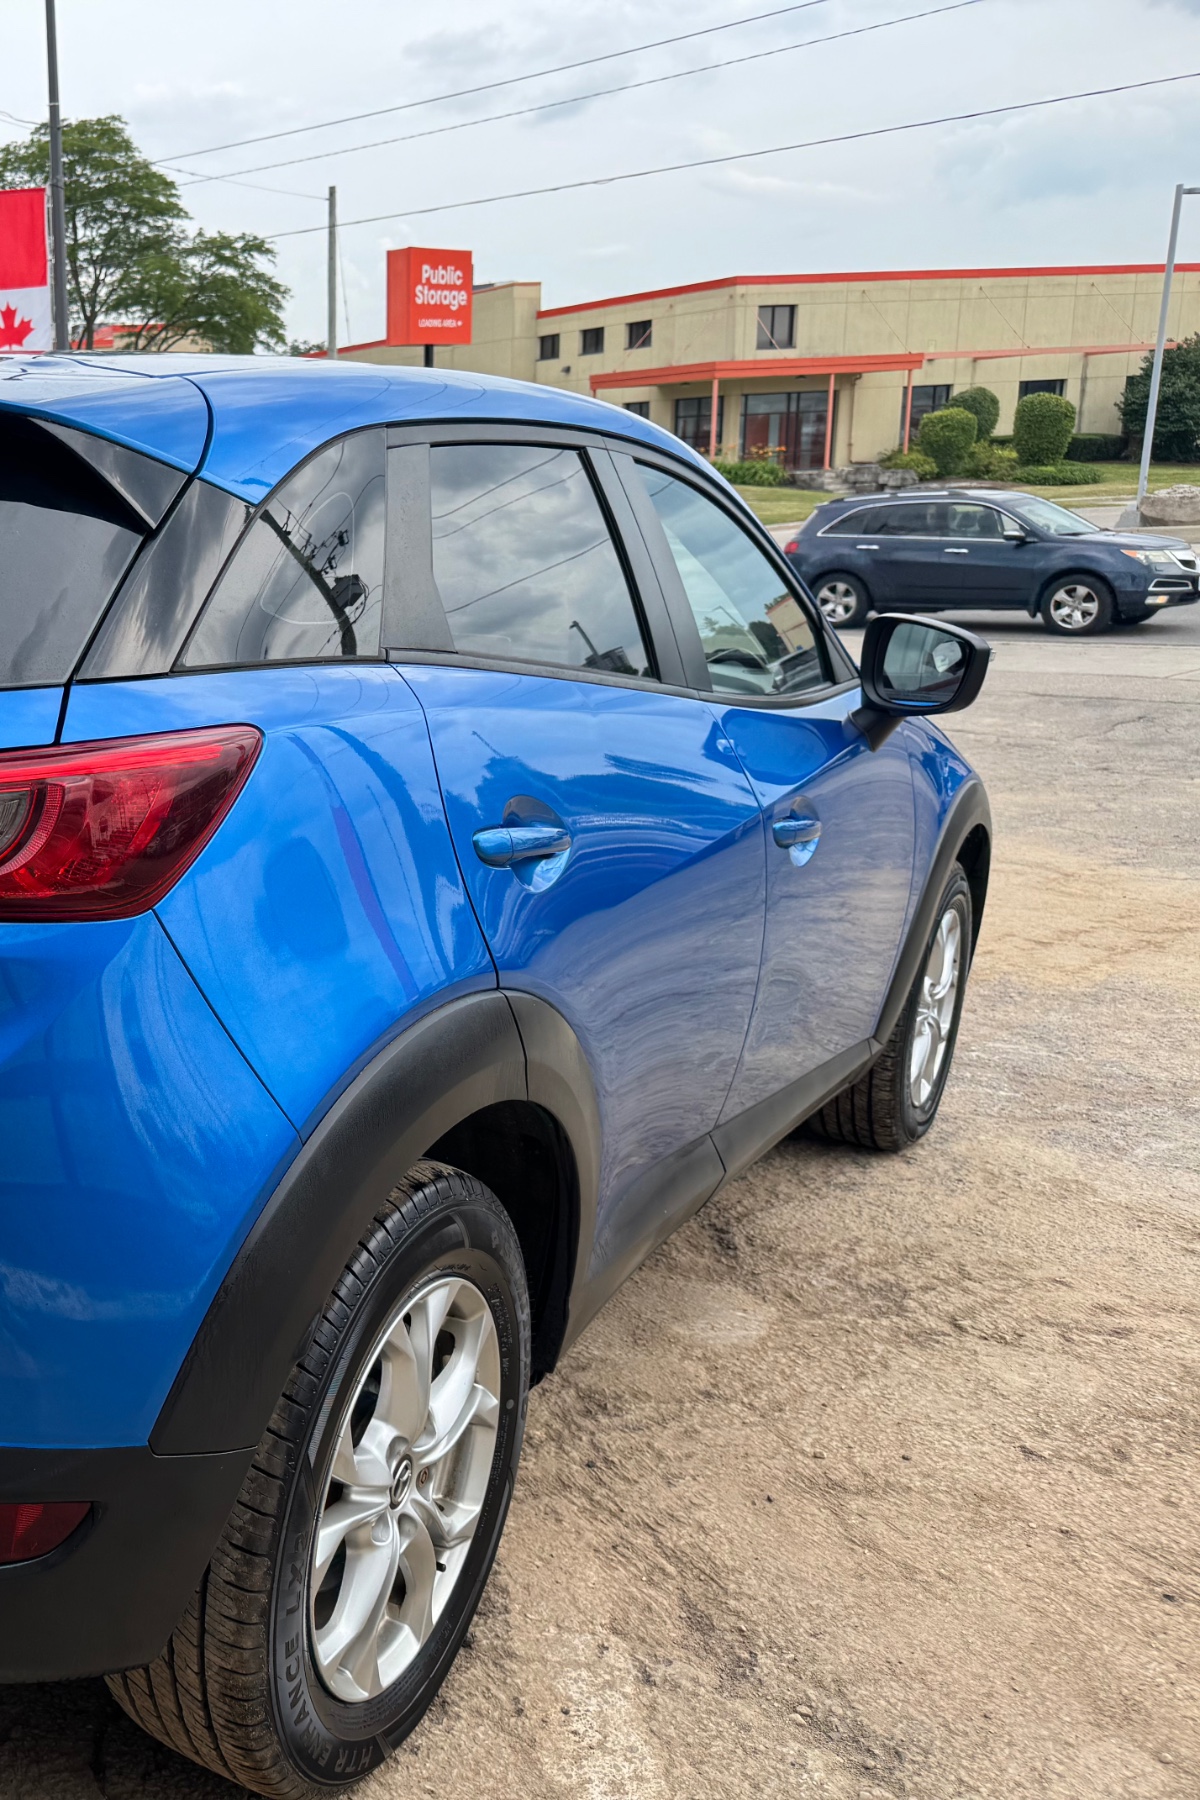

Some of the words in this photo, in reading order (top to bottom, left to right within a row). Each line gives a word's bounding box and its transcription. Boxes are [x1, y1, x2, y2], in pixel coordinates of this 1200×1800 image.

[421, 264, 463, 285] Public
[415, 284, 468, 311] Storage
[285, 1636, 333, 1767] ENHANCE
[334, 1745, 373, 1773] HTR
